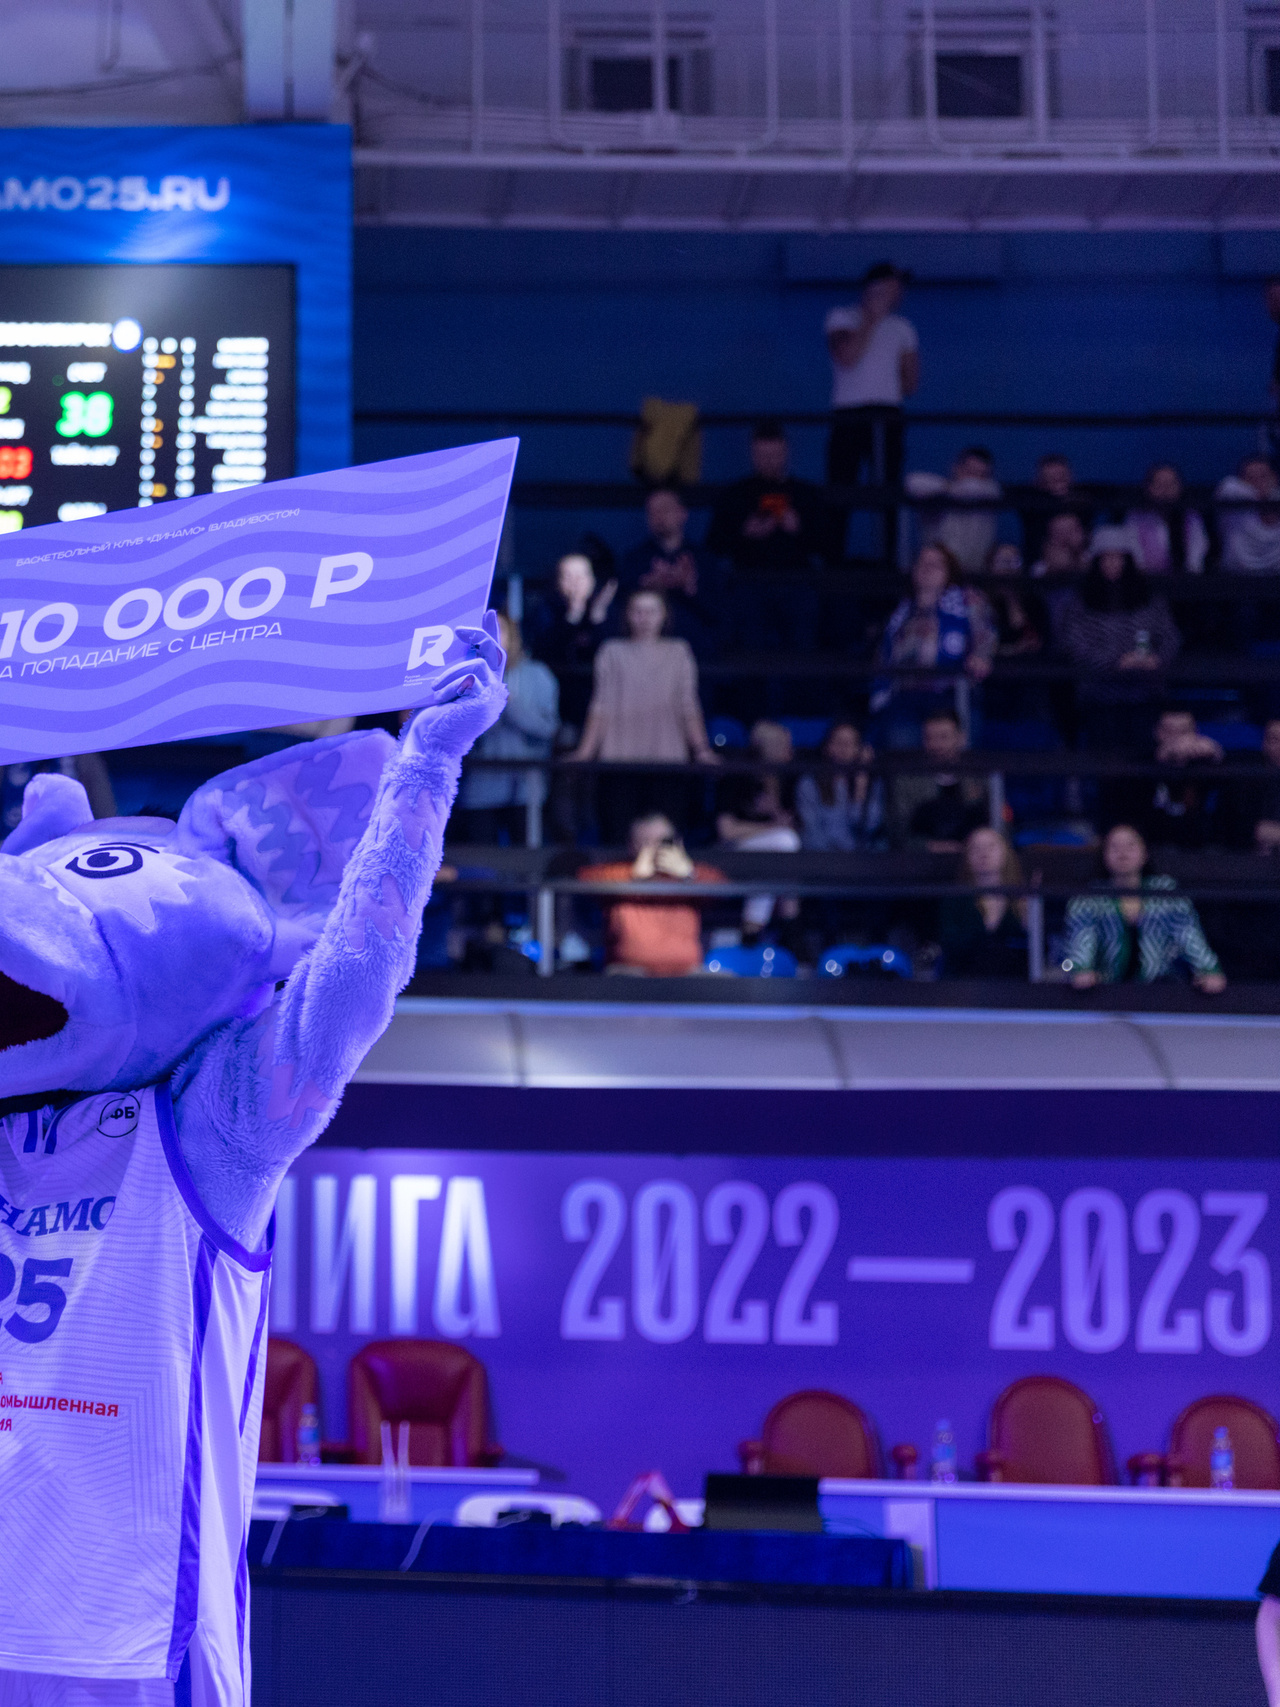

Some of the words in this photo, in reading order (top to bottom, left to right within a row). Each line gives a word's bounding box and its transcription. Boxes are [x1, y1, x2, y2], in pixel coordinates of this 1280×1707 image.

[16, 541, 111, 567] БАСКЕТБОЛЬНЫЙ
[113, 537, 144, 549] КЛУБ
[103, 566, 286, 641] 000
[20, 641, 161, 677] ПОПАДАНИЕ
[190, 622, 283, 652] ЦЕНТРА
[106, 1106, 135, 1119] ФБ
